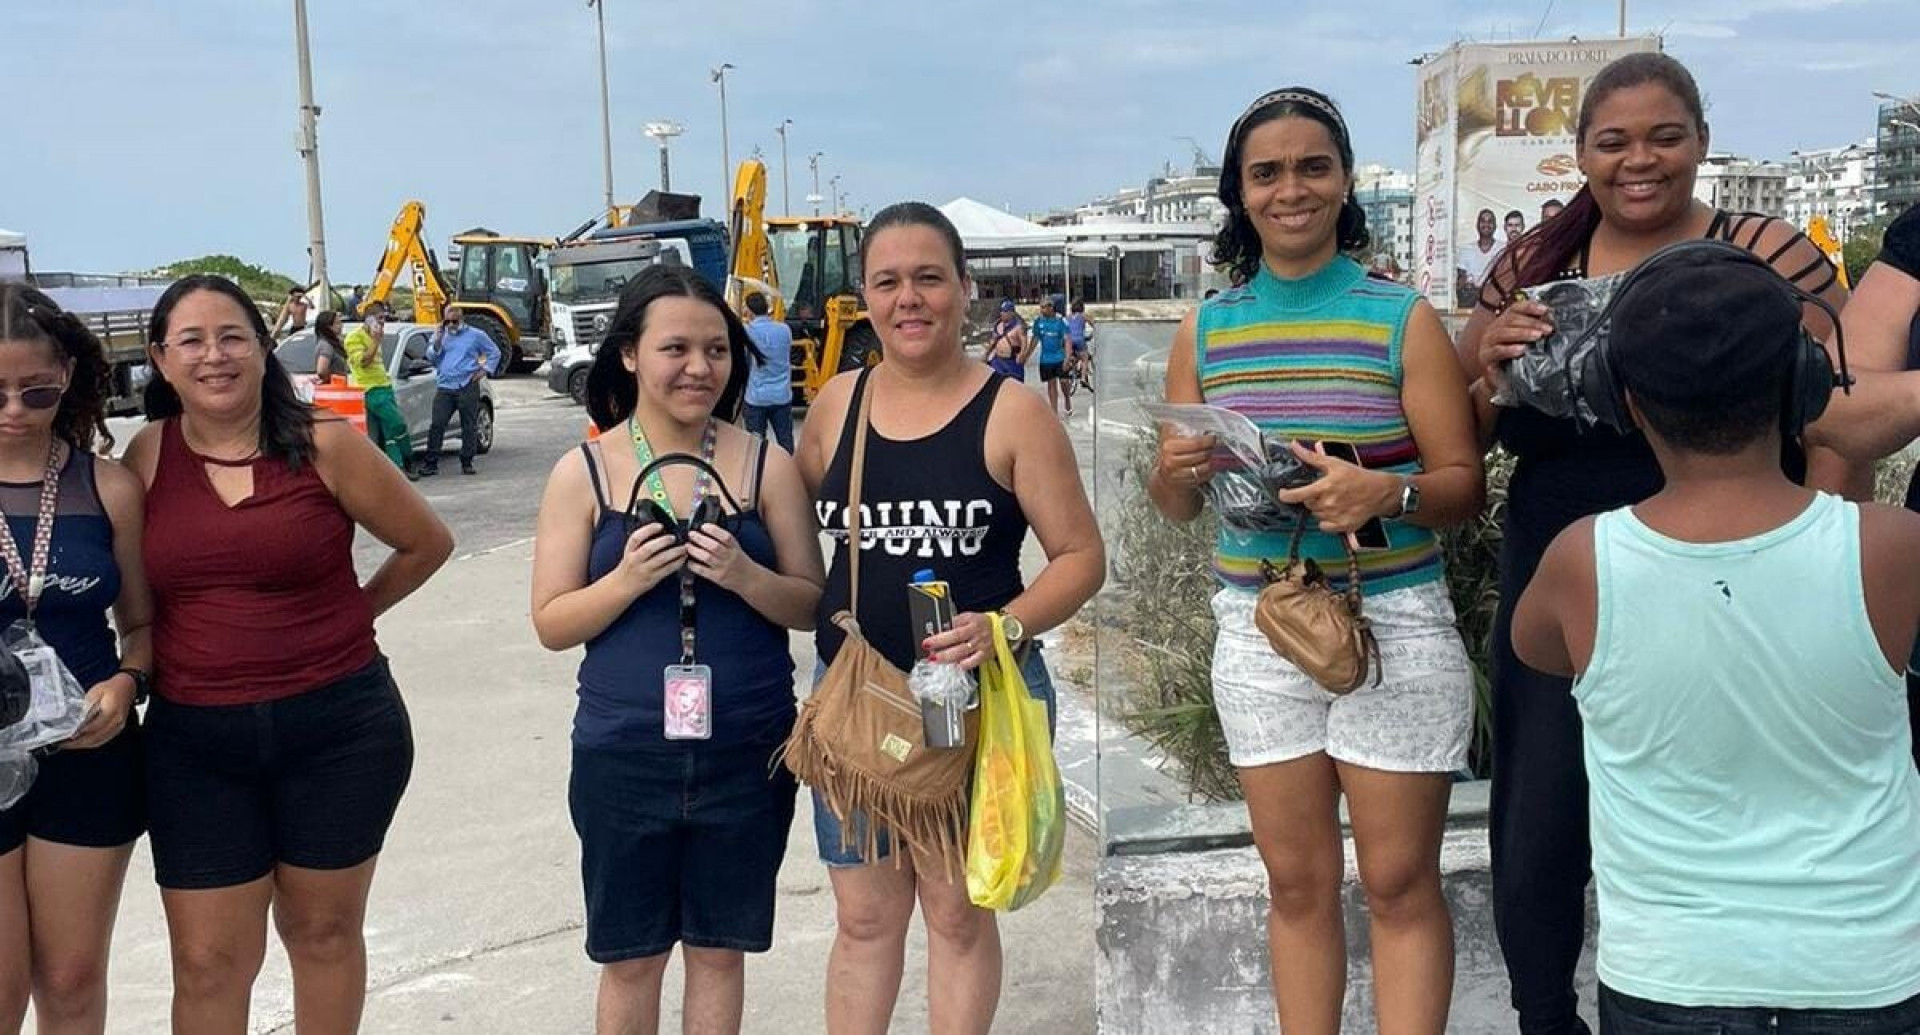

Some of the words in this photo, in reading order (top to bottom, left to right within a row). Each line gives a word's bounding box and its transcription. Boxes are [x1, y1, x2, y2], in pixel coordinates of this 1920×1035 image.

[1526, 182, 1559, 193] CABO
[815, 499, 993, 557] YOUNG
[885, 528, 916, 538] AND
